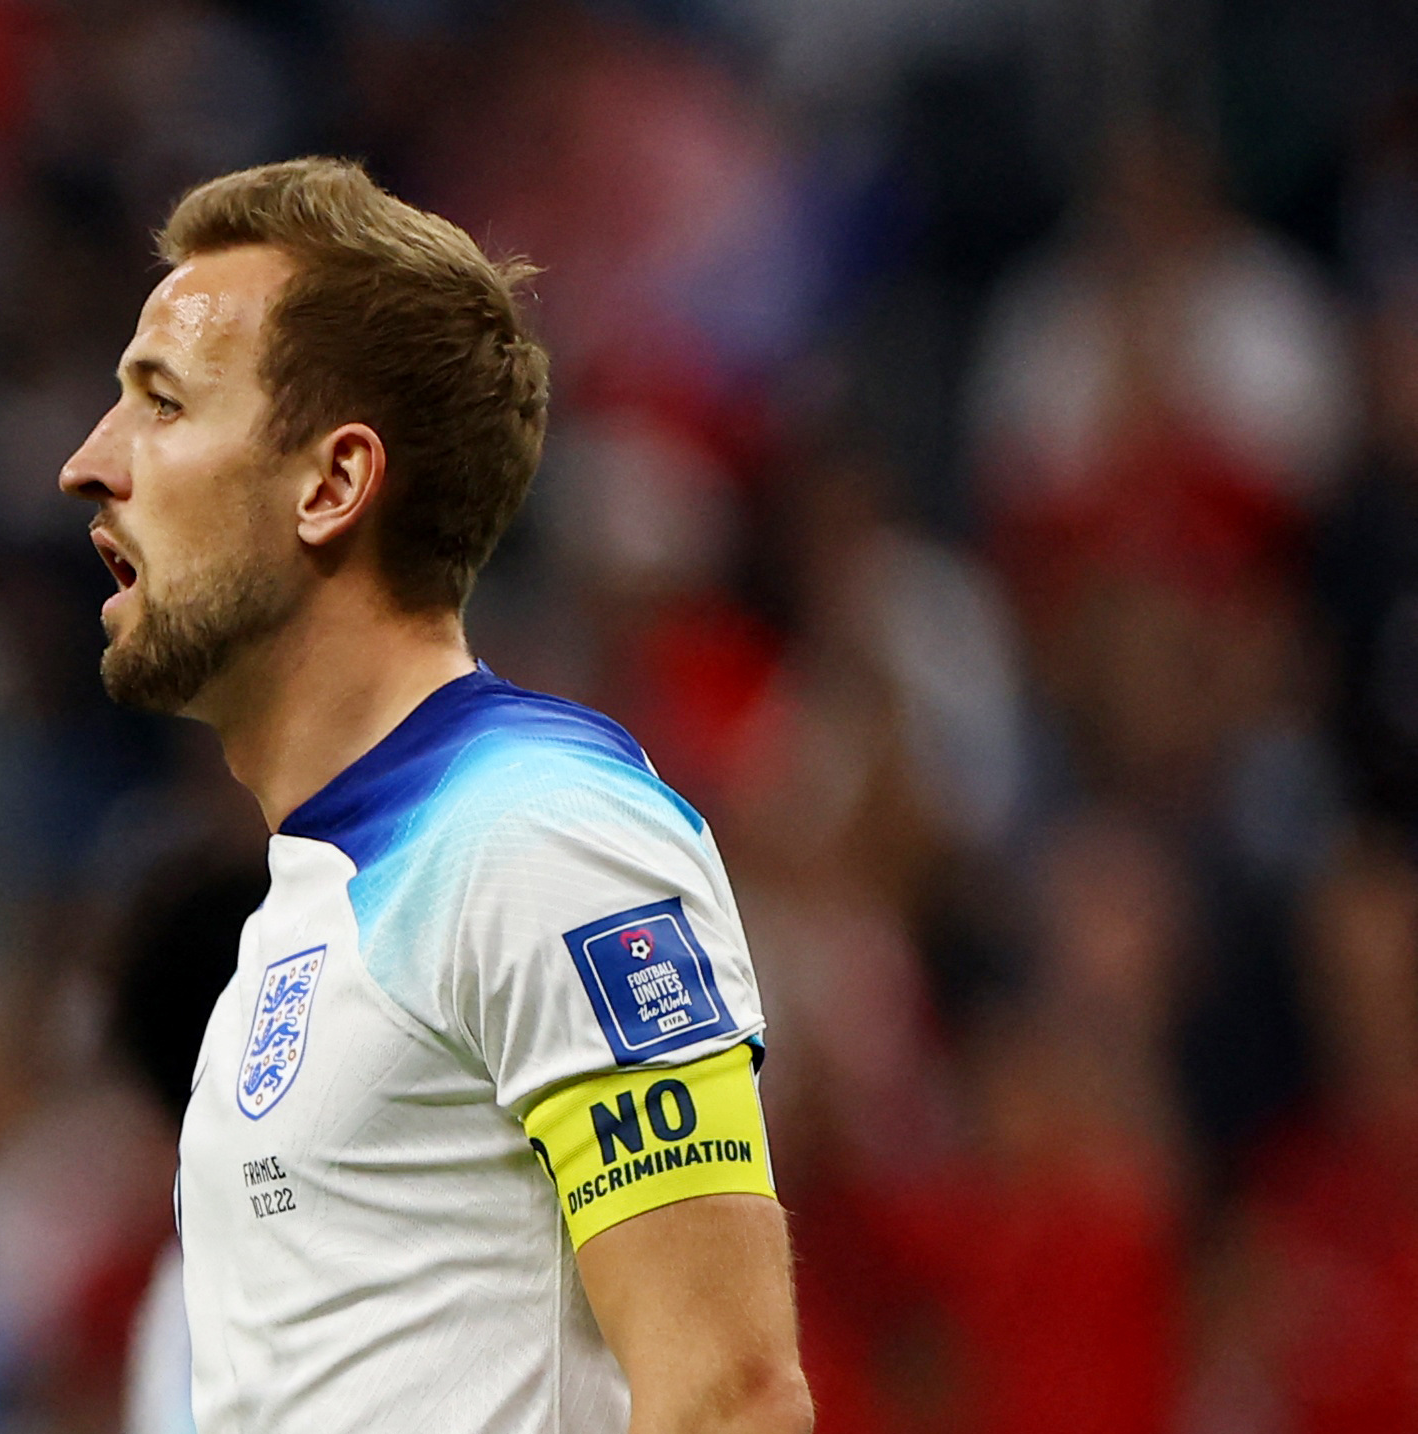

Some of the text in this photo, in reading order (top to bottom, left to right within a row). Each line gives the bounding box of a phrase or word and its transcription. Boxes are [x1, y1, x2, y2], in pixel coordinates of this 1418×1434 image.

[627, 960, 677, 988] FOOTBALL
[632, 974, 684, 1005] UNITES
[637, 990, 692, 1022] the World
[662, 1014, 685, 1028] FIFA
[589, 1078, 698, 1167] NO
[243, 1155, 287, 1188] FRANCE
[567, 1139, 753, 1216] DISCRIMINATION
[250, 1187, 297, 1219] 10.12.22
